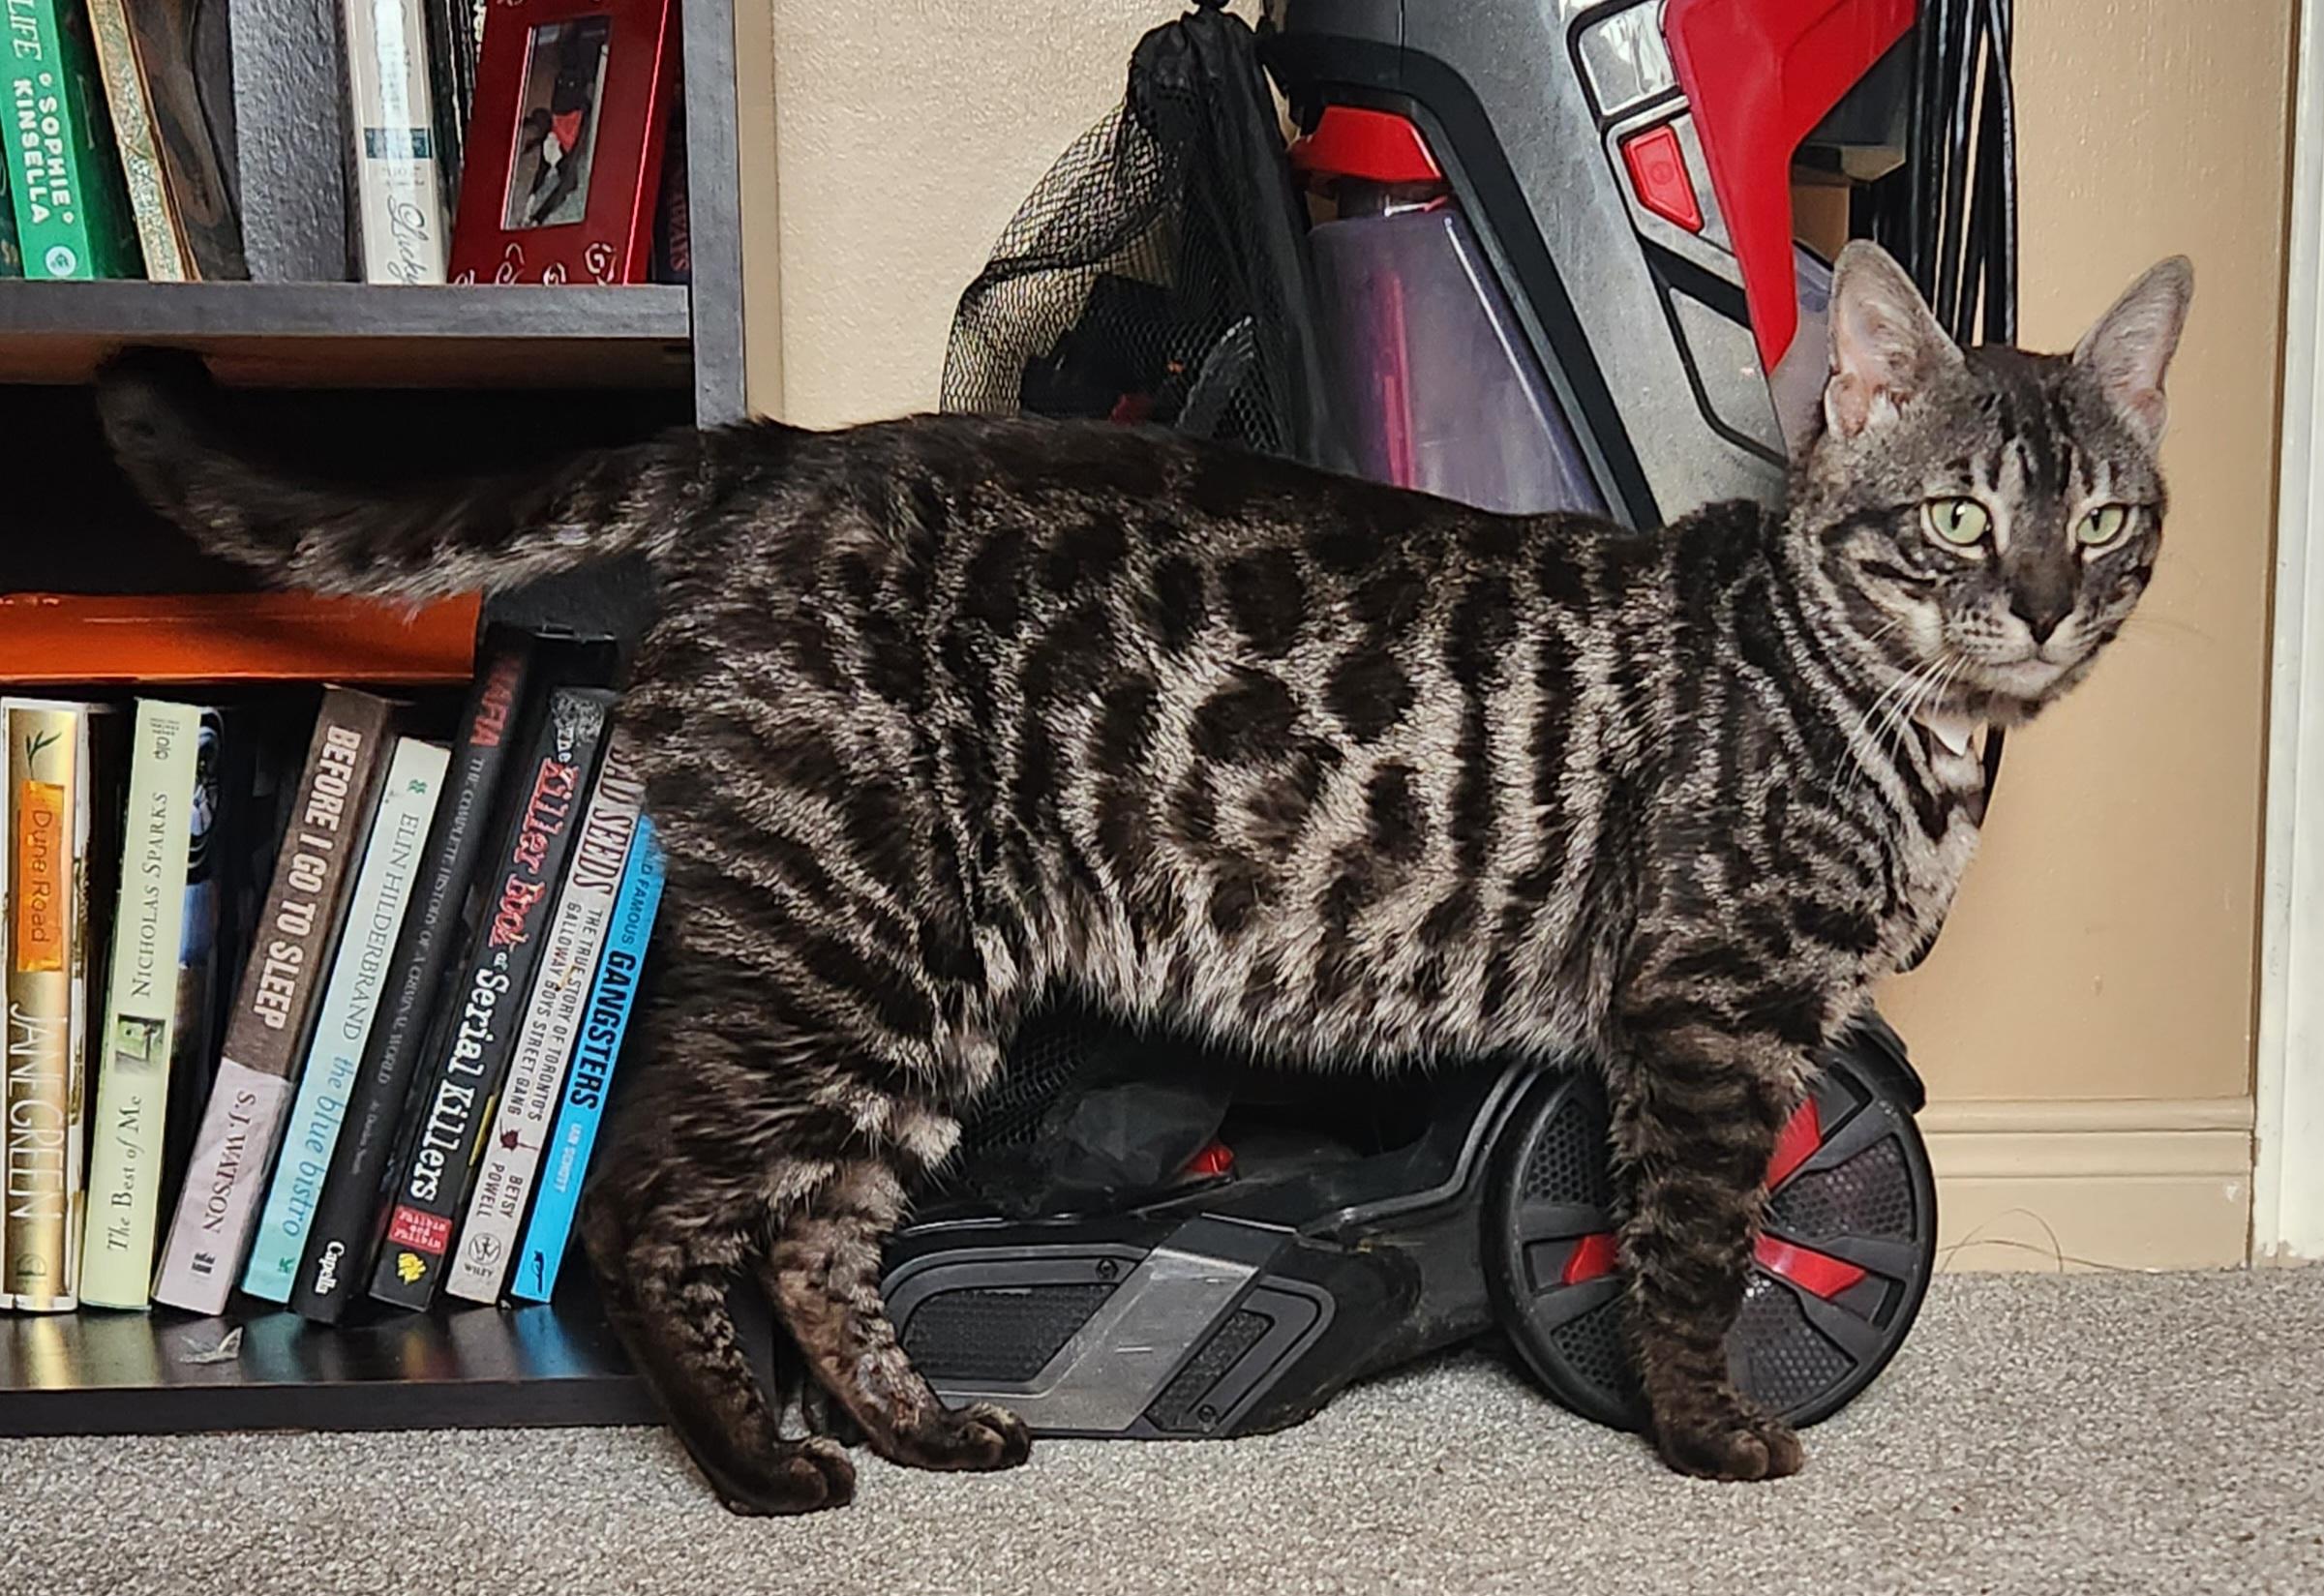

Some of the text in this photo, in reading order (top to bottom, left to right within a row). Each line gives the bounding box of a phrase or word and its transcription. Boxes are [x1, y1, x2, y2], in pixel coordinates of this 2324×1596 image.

[8, 0, 43, 61] LIFE
[14, 78, 50, 225] KINSELLA
[38, 96, 72, 206] SOPHIE
[440, 788, 474, 866] COMPLETE
[513, 757, 580, 874] Killer
[573, 808, 634, 897] SEEDS
[31, 809, 52, 944] Dune Road
[132, 792, 167, 998] NICHOLAS SPARKS
[254, 726, 362, 1030] BEFORE I GO TO SLEEP
[343, 813, 419, 1041] ELIN HILDERBRAND
[423, 865, 455, 927] HISTORY
[489, 874, 545, 952] Book
[621, 877, 649, 946] FAMOUS
[415, 928, 433, 949] OF
[375, 1031, 404, 1085] WORLD
[447, 969, 510, 1076] Serial
[505, 899, 582, 1117] GALLOWAY BOYS STREET GANG
[526, 907, 604, 1124] THE TRUE STORY OF TORONTO'S
[570, 950, 637, 1111] GANGSTERS
[8, 1002, 67, 1220] JANE GREEN
[283, 1056, 354, 1237] the blue bistro
[410, 1078, 478, 1202] Killers
[107, 1095, 146, 1251] The Best of Me
[203, 1133, 248, 1234] WATSON
[474, 1160, 506, 1220] POWELL
[496, 1173, 525, 1220] BETSY
